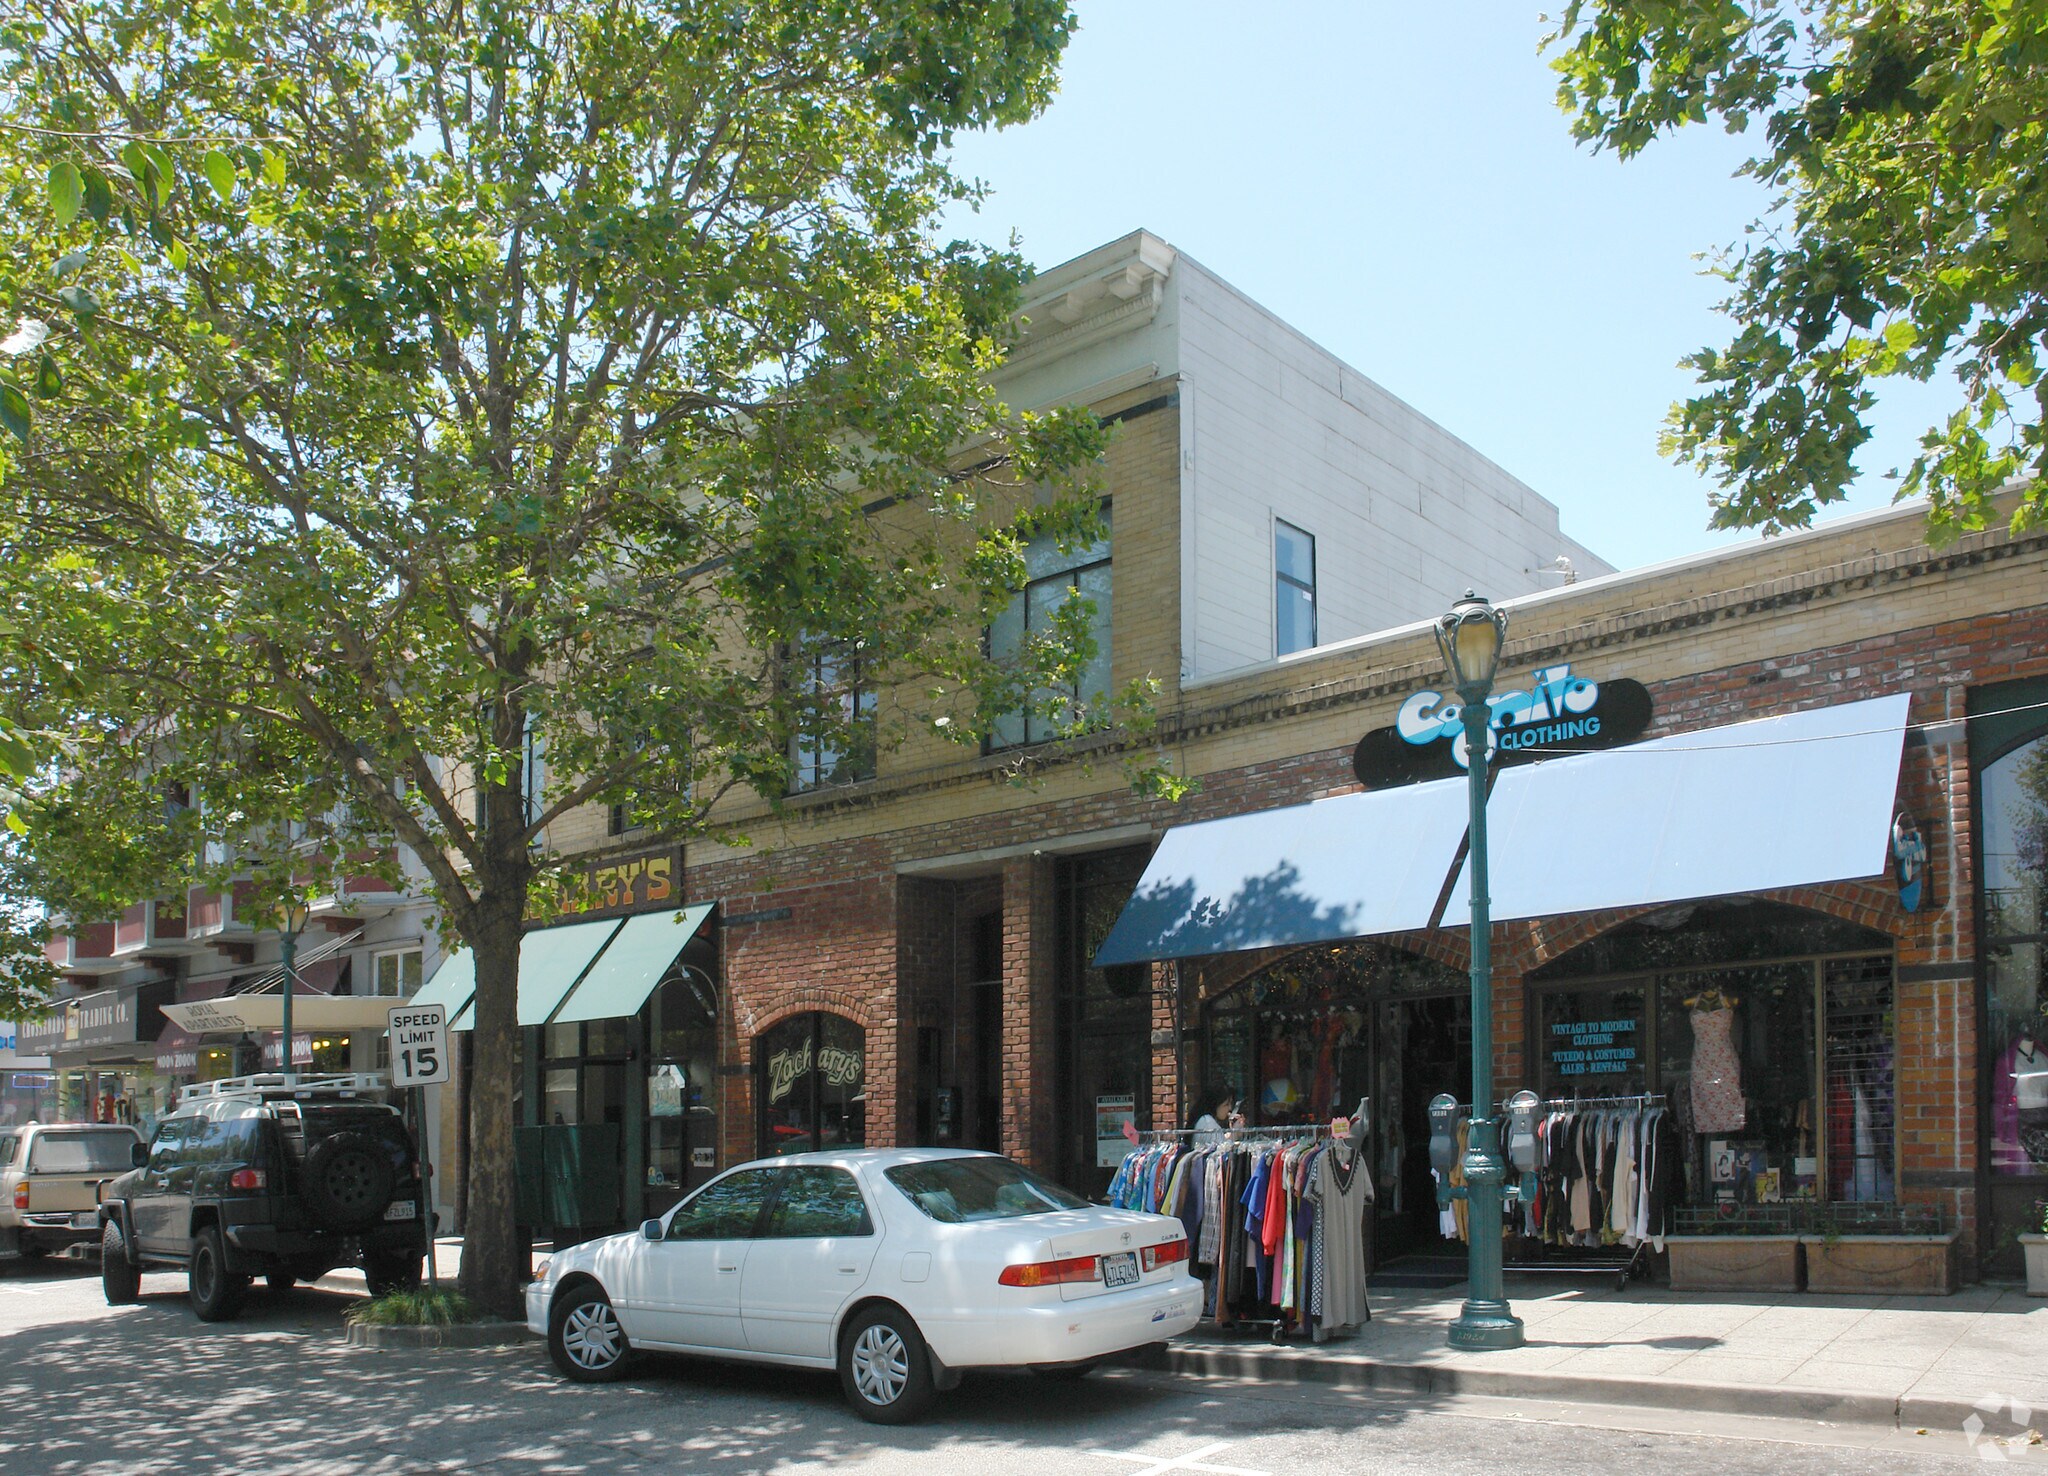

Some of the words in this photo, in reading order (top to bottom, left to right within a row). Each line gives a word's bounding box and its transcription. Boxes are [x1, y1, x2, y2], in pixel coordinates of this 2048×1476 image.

[1500, 717, 1600, 750] CLOTHING
[80, 1005, 113, 1029] TRADING
[185, 1003, 219, 1017] ROYAL
[182, 1015, 245, 1031] APARTMENTS
[394, 1014, 440, 1028] SPEED
[1552, 1022, 1587, 1035] VINTAGE
[1587, 1022, 1599, 1034] TO
[1600, 1020, 1636, 1033] MODERN
[400, 1031, 435, 1044] LIMIT
[1573, 1033, 1613, 1046] CLOTHING
[1552, 1050, 1585, 1062] TUXEDO
[1586, 1050, 1593, 1061] &
[1594, 1047, 1636, 1060] COSTUMES
[402, 1048, 439, 1077] 15
[1561, 1062, 1585, 1075] SALES
[1590, 1061, 1627, 1073] RENTALS
